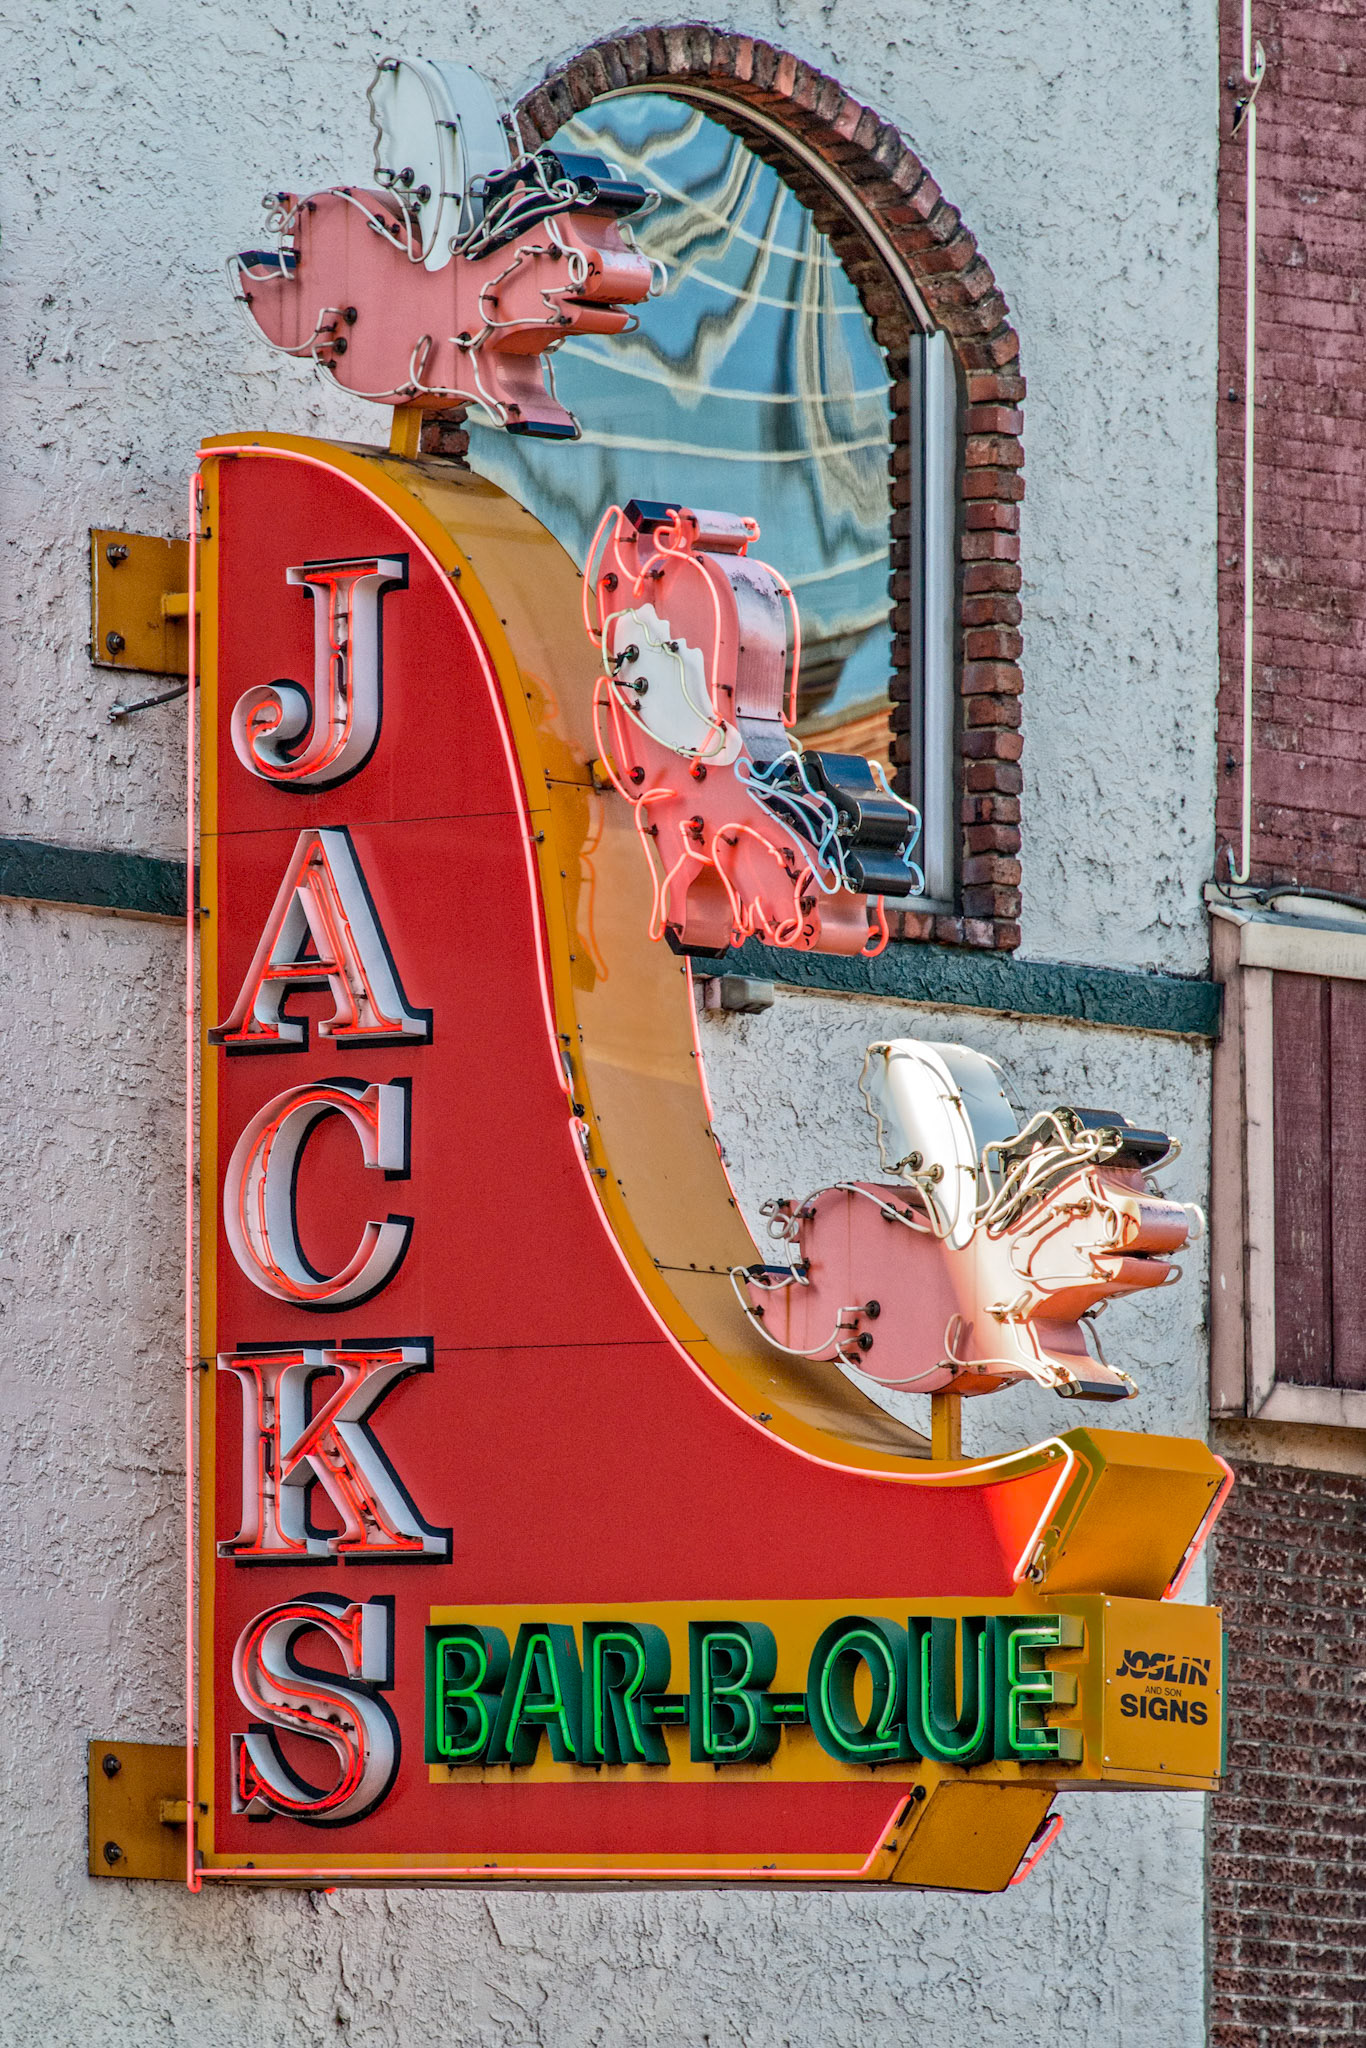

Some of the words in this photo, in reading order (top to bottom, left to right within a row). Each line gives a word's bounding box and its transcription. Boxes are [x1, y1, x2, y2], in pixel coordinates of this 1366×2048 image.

[207, 552, 453, 1829] JACKS
[1116, 1649, 1211, 1686] JOSLIN
[424, 1614, 1084, 1766] BAR-B-QUE
[1145, 1686, 1162, 1695] AND
[1164, 1687, 1182, 1697] SON
[1120, 1693, 1208, 1725] SIGNS
